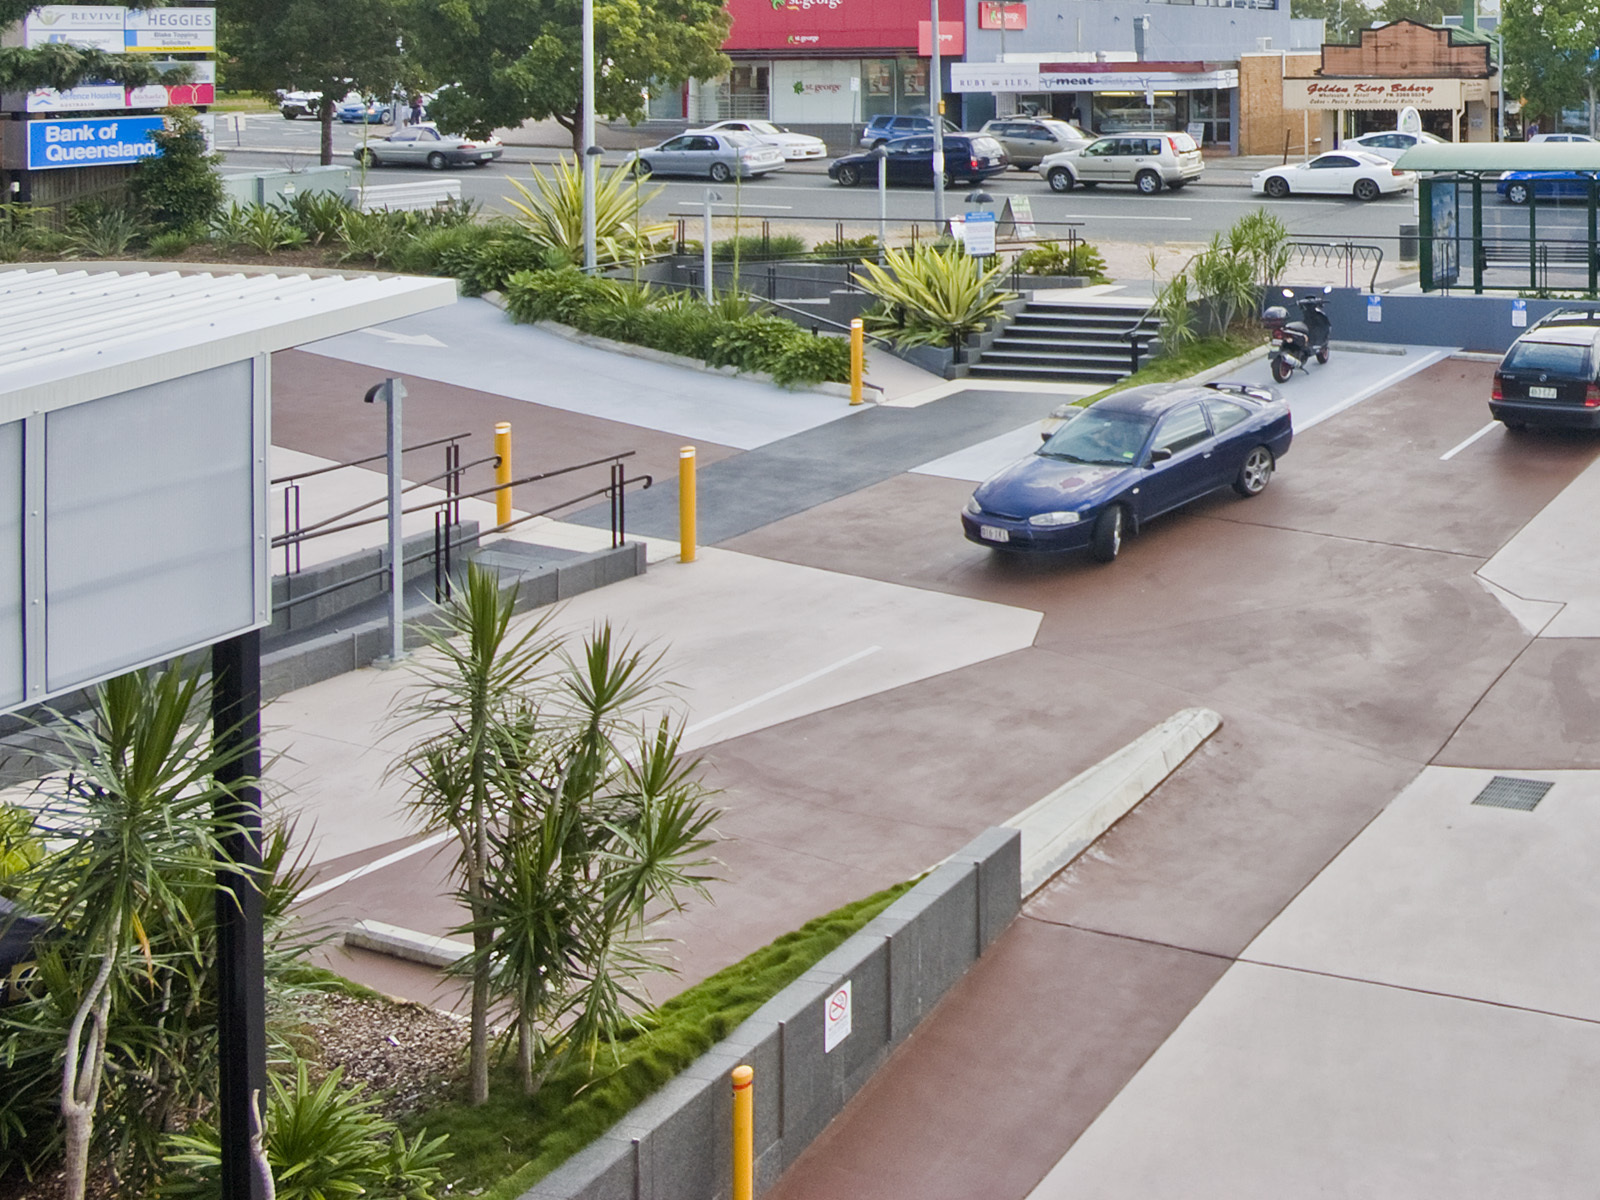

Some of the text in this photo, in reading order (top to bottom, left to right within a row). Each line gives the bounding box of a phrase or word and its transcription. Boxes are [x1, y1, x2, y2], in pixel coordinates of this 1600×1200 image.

[71, 12, 121, 21] REVIVE
[148, 14, 212, 26] HEGGIES
[1056, 75, 1094, 85] meat
[1307, 83, 1434, 95] Golden King Bakery
[91, 91, 122, 101] Housing
[45, 123, 118, 143] Bank of
[46, 141, 156, 162] Queensland
